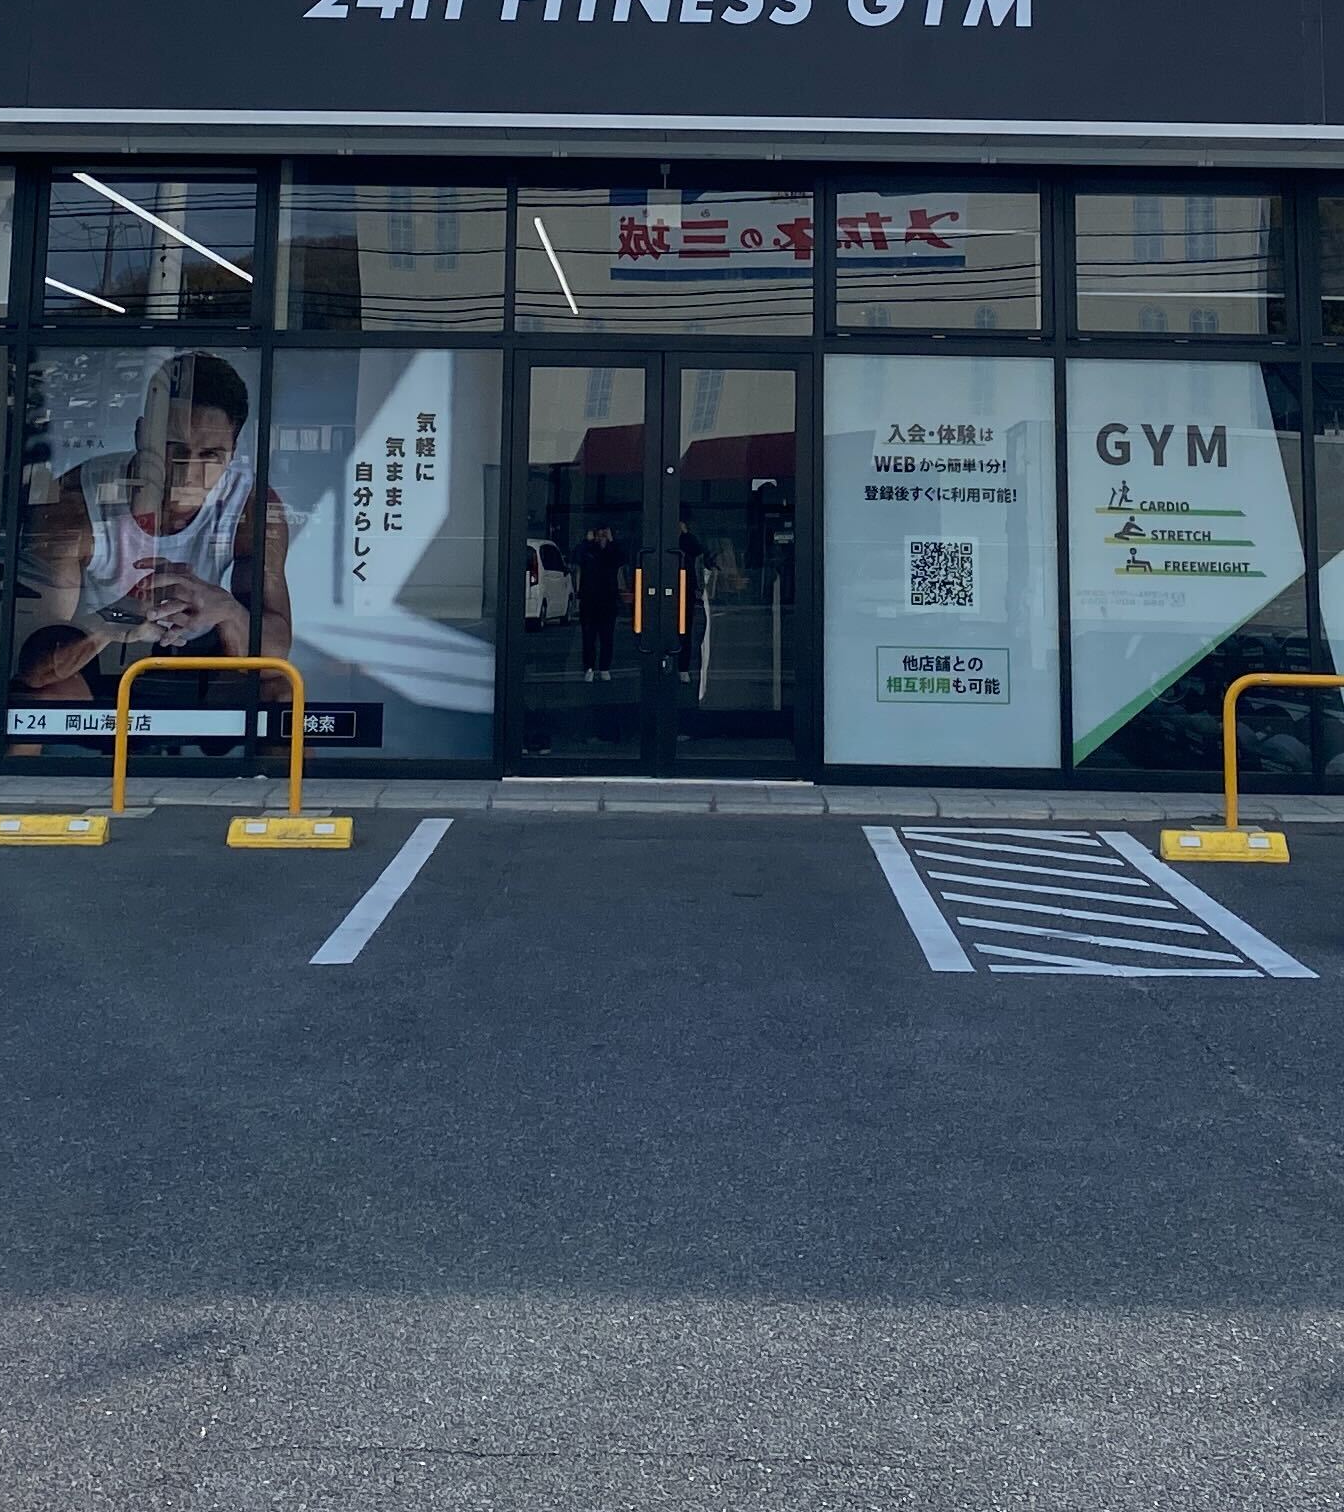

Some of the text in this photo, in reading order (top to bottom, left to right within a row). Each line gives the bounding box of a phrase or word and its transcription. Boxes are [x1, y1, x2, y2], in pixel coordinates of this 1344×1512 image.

[415, 413, 437, 481] 気軽に
[1096, 422, 1228, 468] GYM
[384, 437, 405, 532] 気ままに
[1140, 500, 1190, 513] CARDIO
[353, 462, 373, 582] 自分らしく
[1151, 529, 1212, 542] STRETCH
[1164, 560, 1251, 574] FREEWEIGHT
[902, 655, 983, 673] 他店舗との
[886, 677, 1001, 696] 相互利用も可能
[303, 715, 335, 733] 検索
